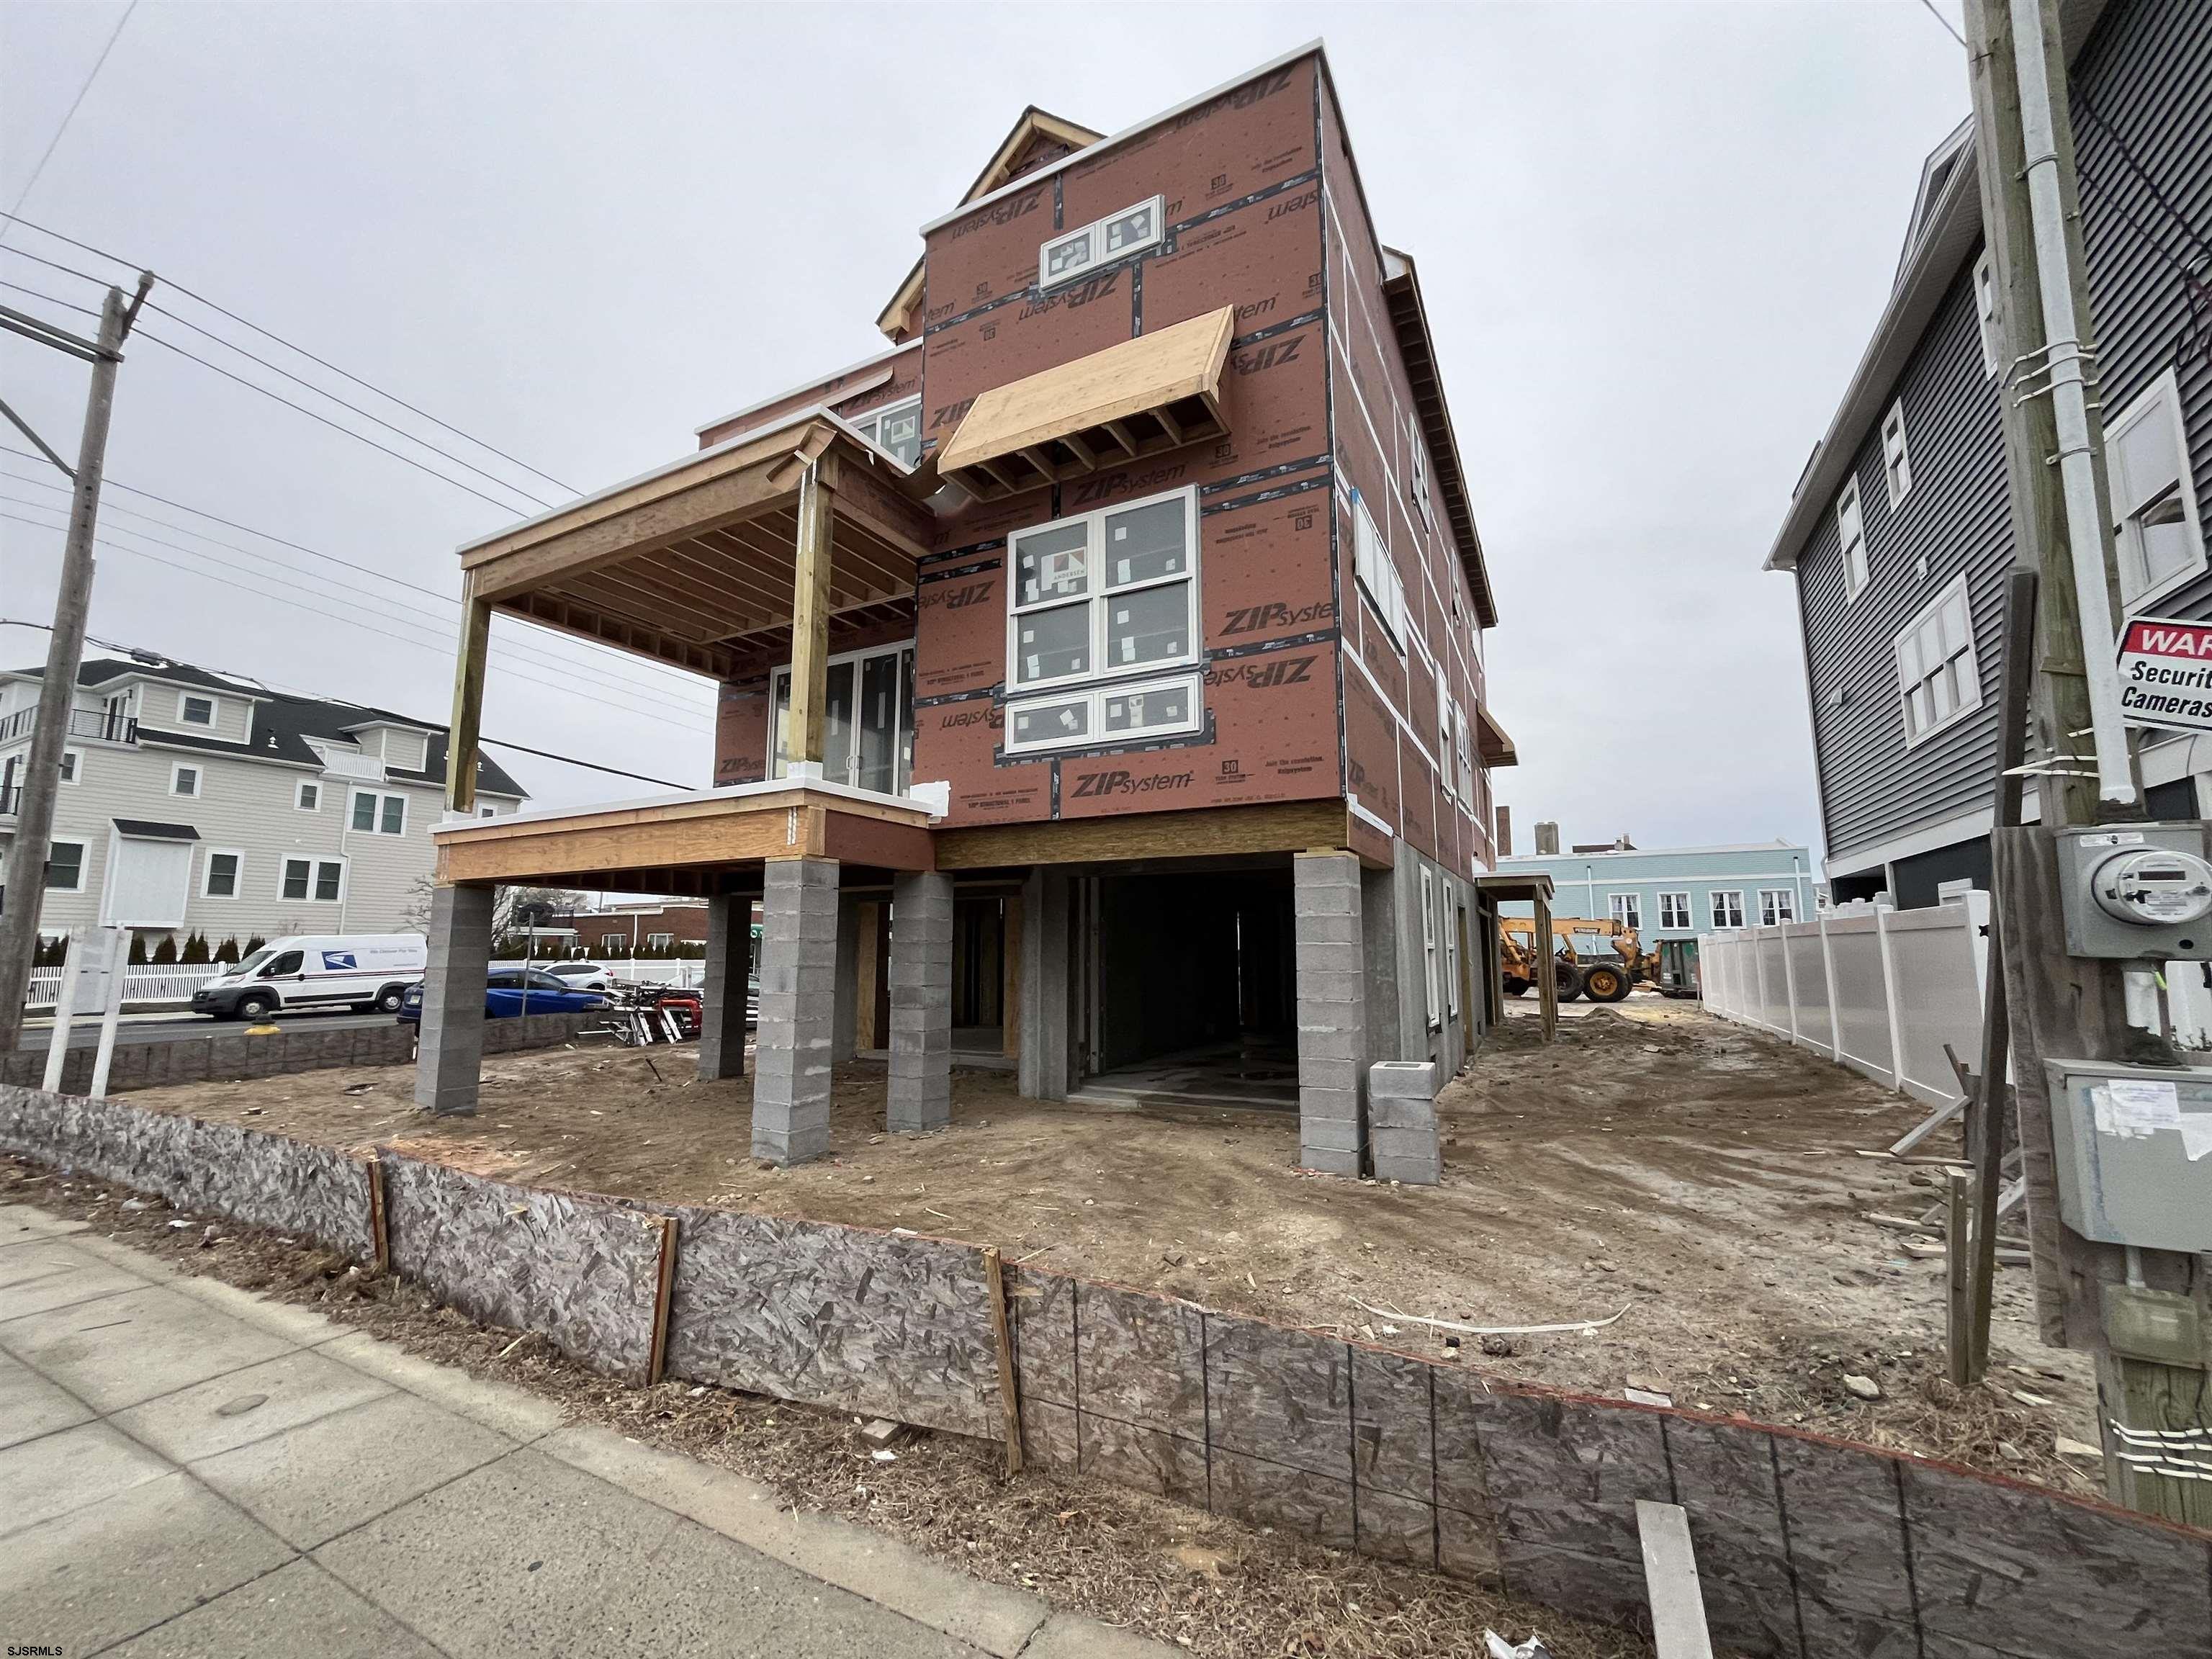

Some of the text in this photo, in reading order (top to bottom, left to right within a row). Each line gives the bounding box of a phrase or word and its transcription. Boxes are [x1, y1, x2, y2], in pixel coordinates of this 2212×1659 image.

[1297, 517, 1311, 530] 30
[918, 580, 995, 610] ZIPsyste
[1218, 602, 1334, 637] ZIPsyste
[2142, 629, 2212, 656] WAR
[1204, 655, 1318, 689] ZIPsyste
[2132, 660, 2212, 690] Securit
[2121, 686, 2212, 718] Cameras
[940, 709, 1004, 729] Psystem
[1223, 761, 1238, 773] 30
[1070, 770, 1191, 799] ZIPsystem
